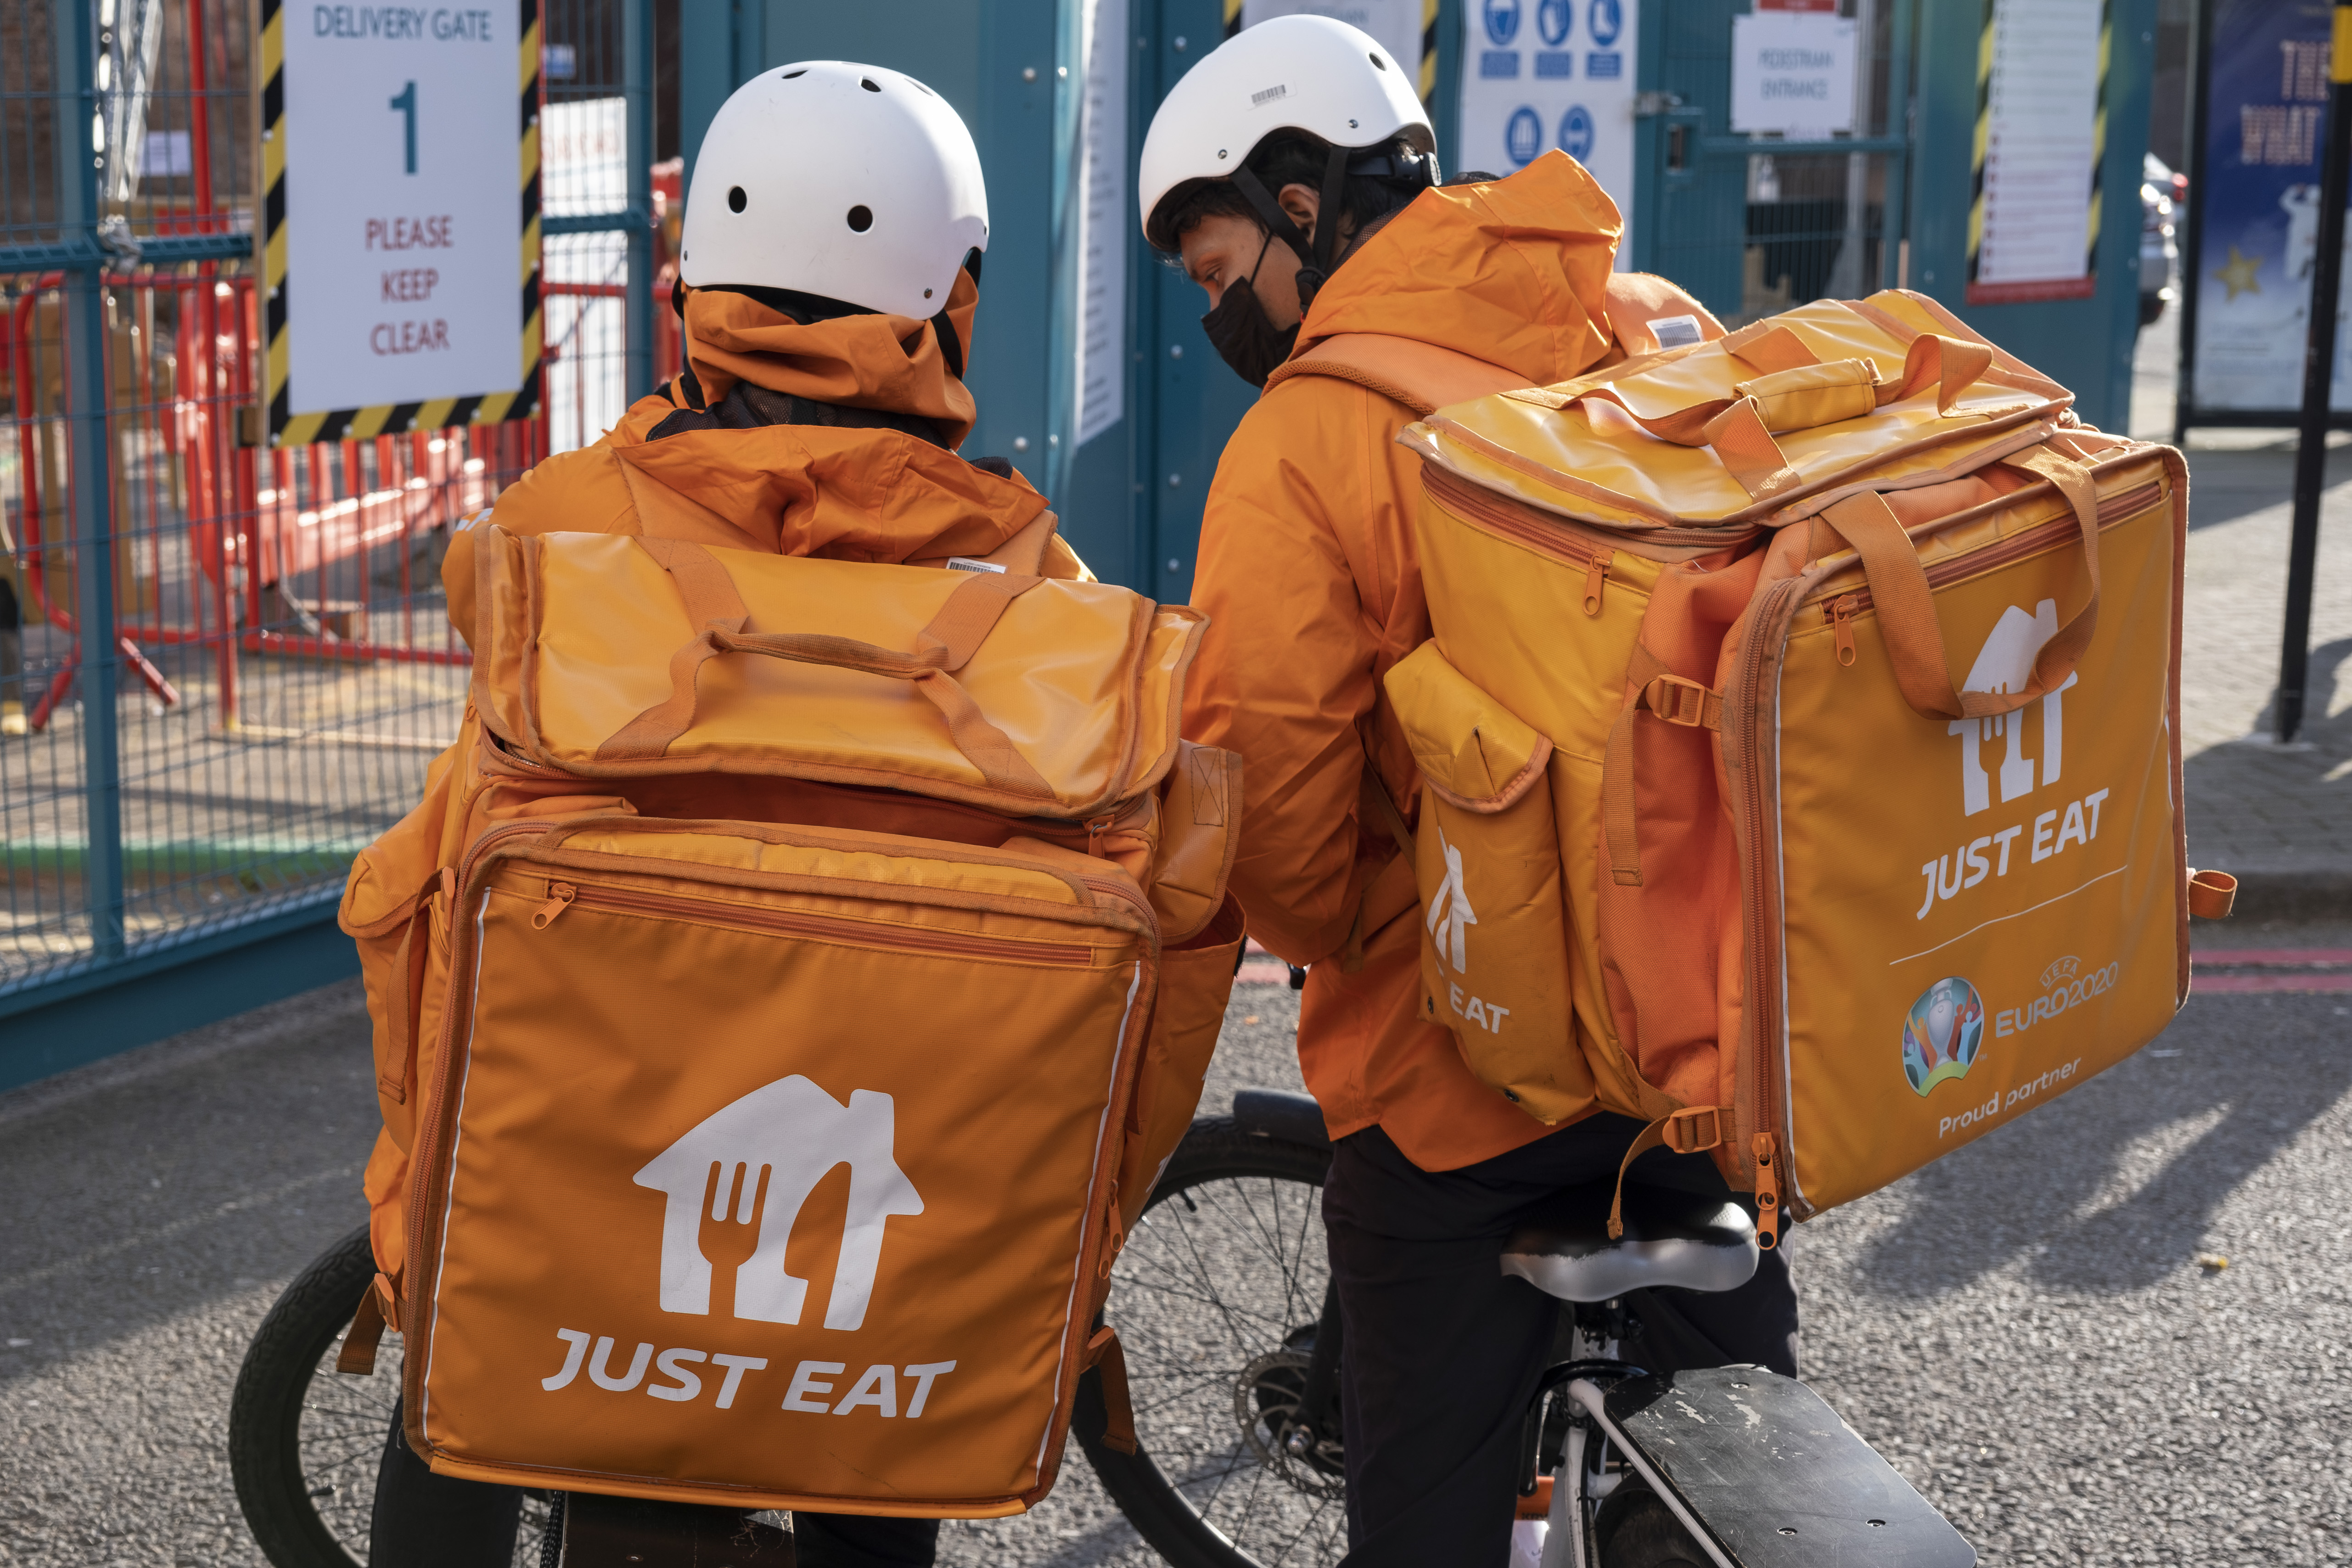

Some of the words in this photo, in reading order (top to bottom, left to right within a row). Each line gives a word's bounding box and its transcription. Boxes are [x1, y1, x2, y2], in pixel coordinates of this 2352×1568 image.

[314, 4, 427, 39] DELIVERY
[431, 8, 493, 42] GATE
[389, 79, 418, 175] 1
[2240, 104, 2320, 166] WHAT
[366, 216, 453, 251] PLEASE
[381, 268, 439, 303] KEEP
[370, 319, 450, 356] CLEAR
[1916, 825, 2021, 920] JUST
[2031, 787, 2109, 864] EAT
[2042, 960, 2077, 987] UEFA
[1450, 981, 1510, 1034] EAT
[1939, 1091, 1999, 1139] Proud
[2004, 1057, 2081, 1111] partner
[542, 1328, 768, 1409] JUST
[781, 1360, 957, 1419] EAT
